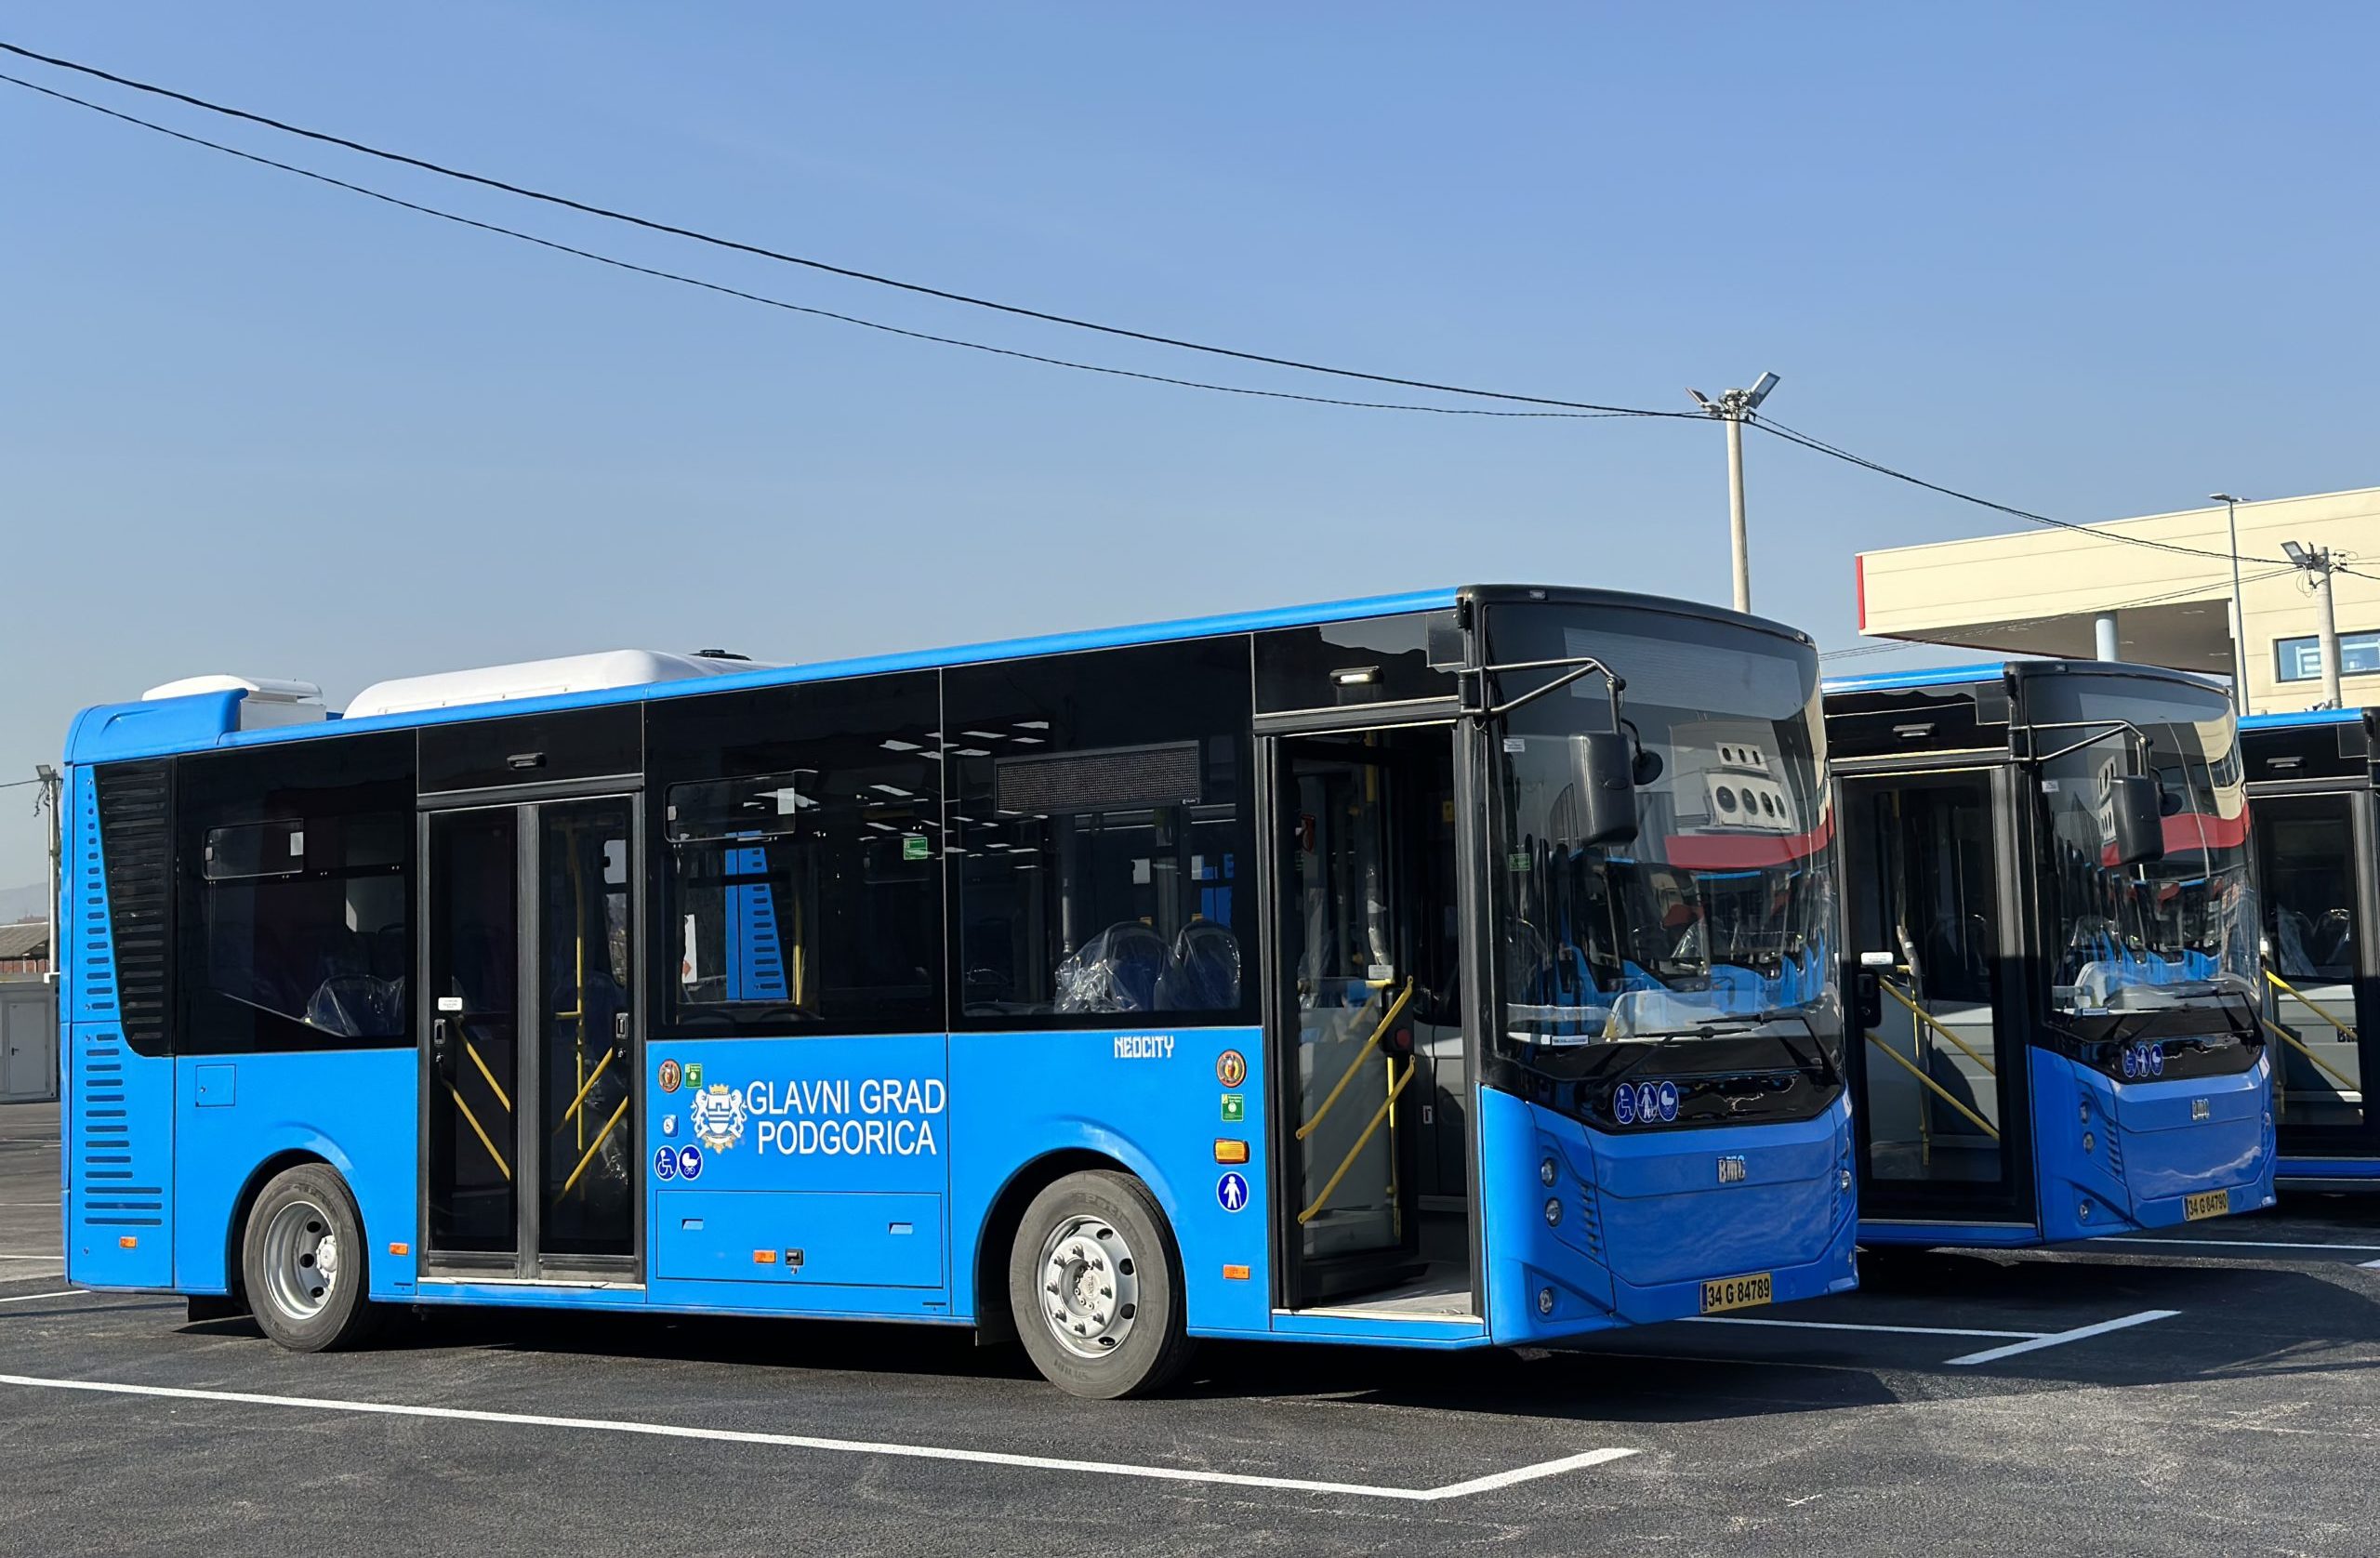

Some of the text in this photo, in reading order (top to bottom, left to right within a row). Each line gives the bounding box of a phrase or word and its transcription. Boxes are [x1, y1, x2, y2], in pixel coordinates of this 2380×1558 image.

[1114, 1036, 1174, 1058] NEOCITY
[747, 1079, 945, 1115] GLAVNI GRAD
[758, 1119, 937, 1155] PODGORICA
[1718, 1155, 1745, 1182] BMC
[2188, 1198, 2198, 1215] 34
[2200, 1198, 2205, 1214] G
[1708, 1277, 1770, 1307] 34 G 84789
